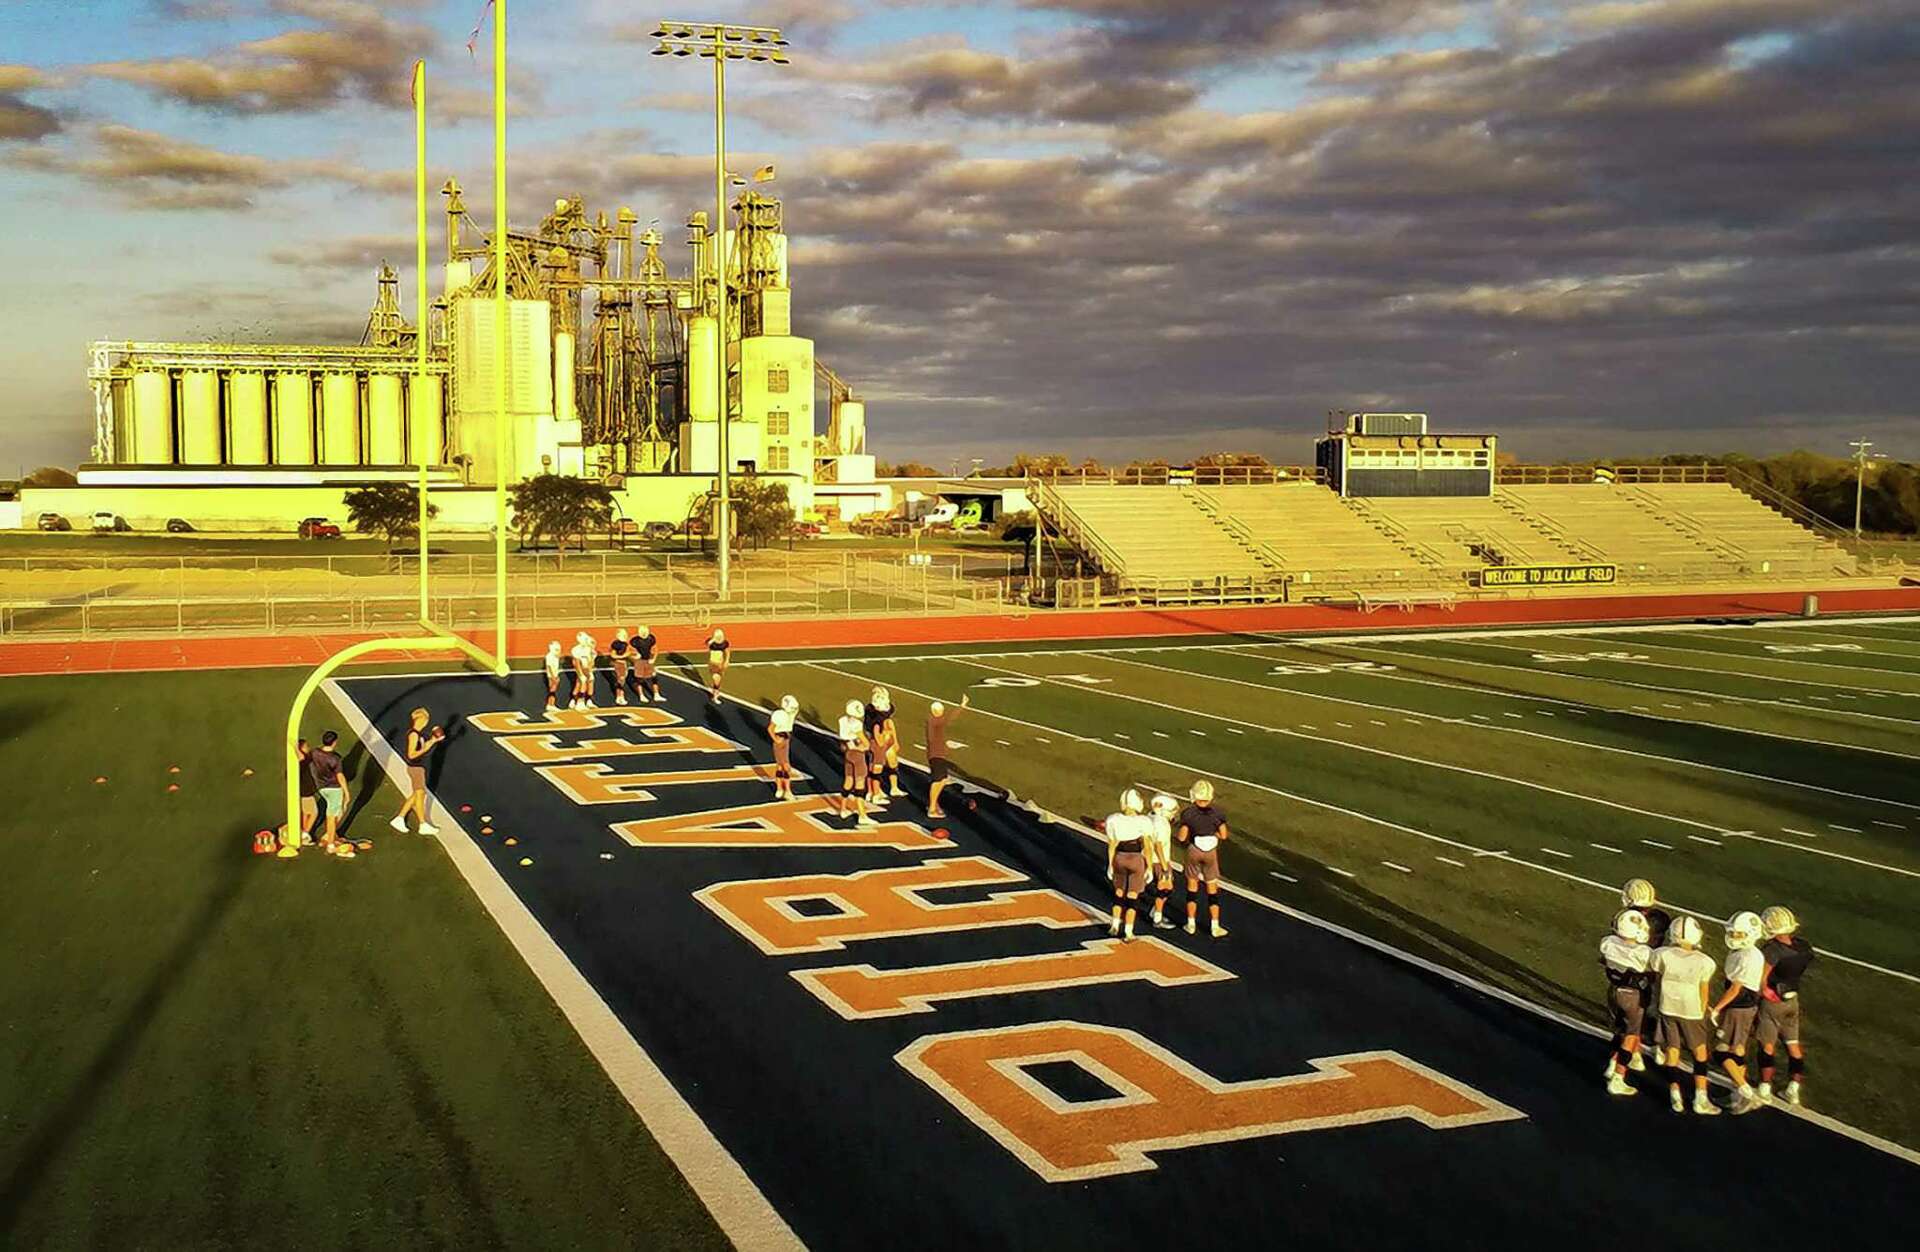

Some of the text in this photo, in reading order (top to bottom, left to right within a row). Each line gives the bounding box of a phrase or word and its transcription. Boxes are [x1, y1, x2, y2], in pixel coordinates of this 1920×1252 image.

[1485, 568, 1613, 583] WELCOME TO JACK LANE FIELD
[467, 706, 1527, 1183] PIRATES
